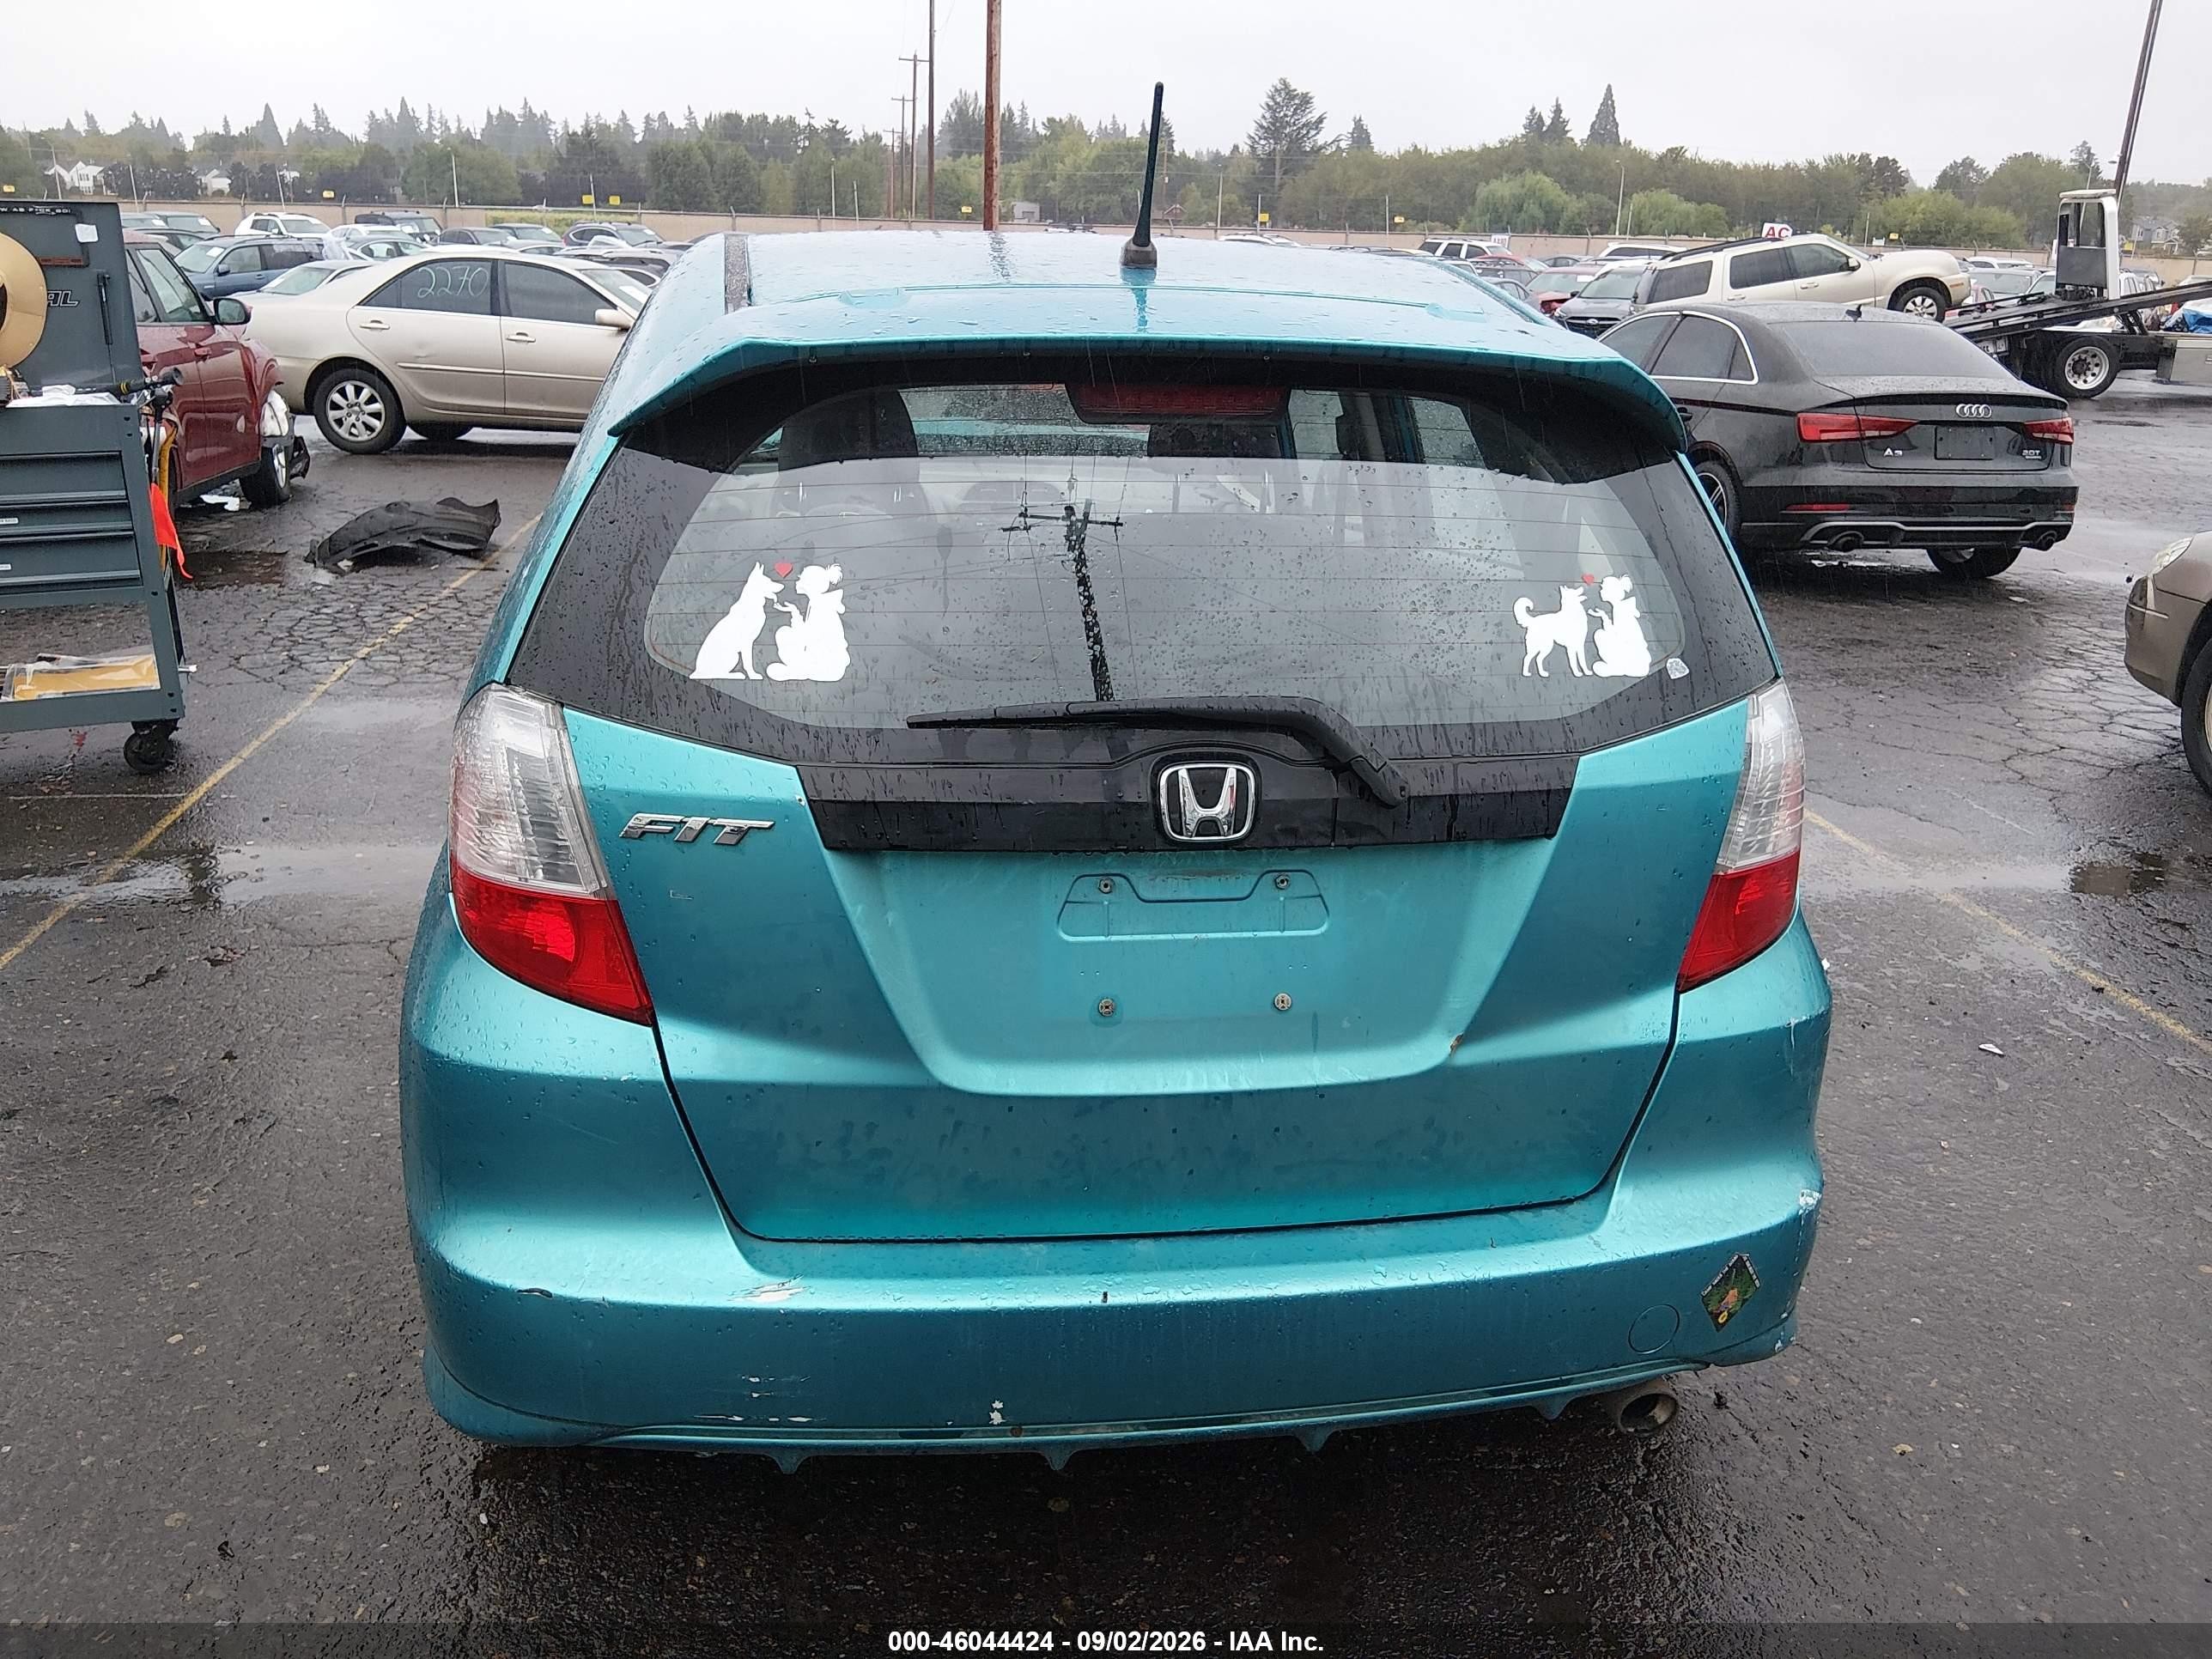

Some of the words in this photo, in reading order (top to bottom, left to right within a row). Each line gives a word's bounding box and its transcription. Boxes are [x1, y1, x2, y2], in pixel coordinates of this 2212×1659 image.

[417, 266, 489, 298] 2270
[1883, 447, 1903, 457] A3
[619, 812, 775, 845] FIT
